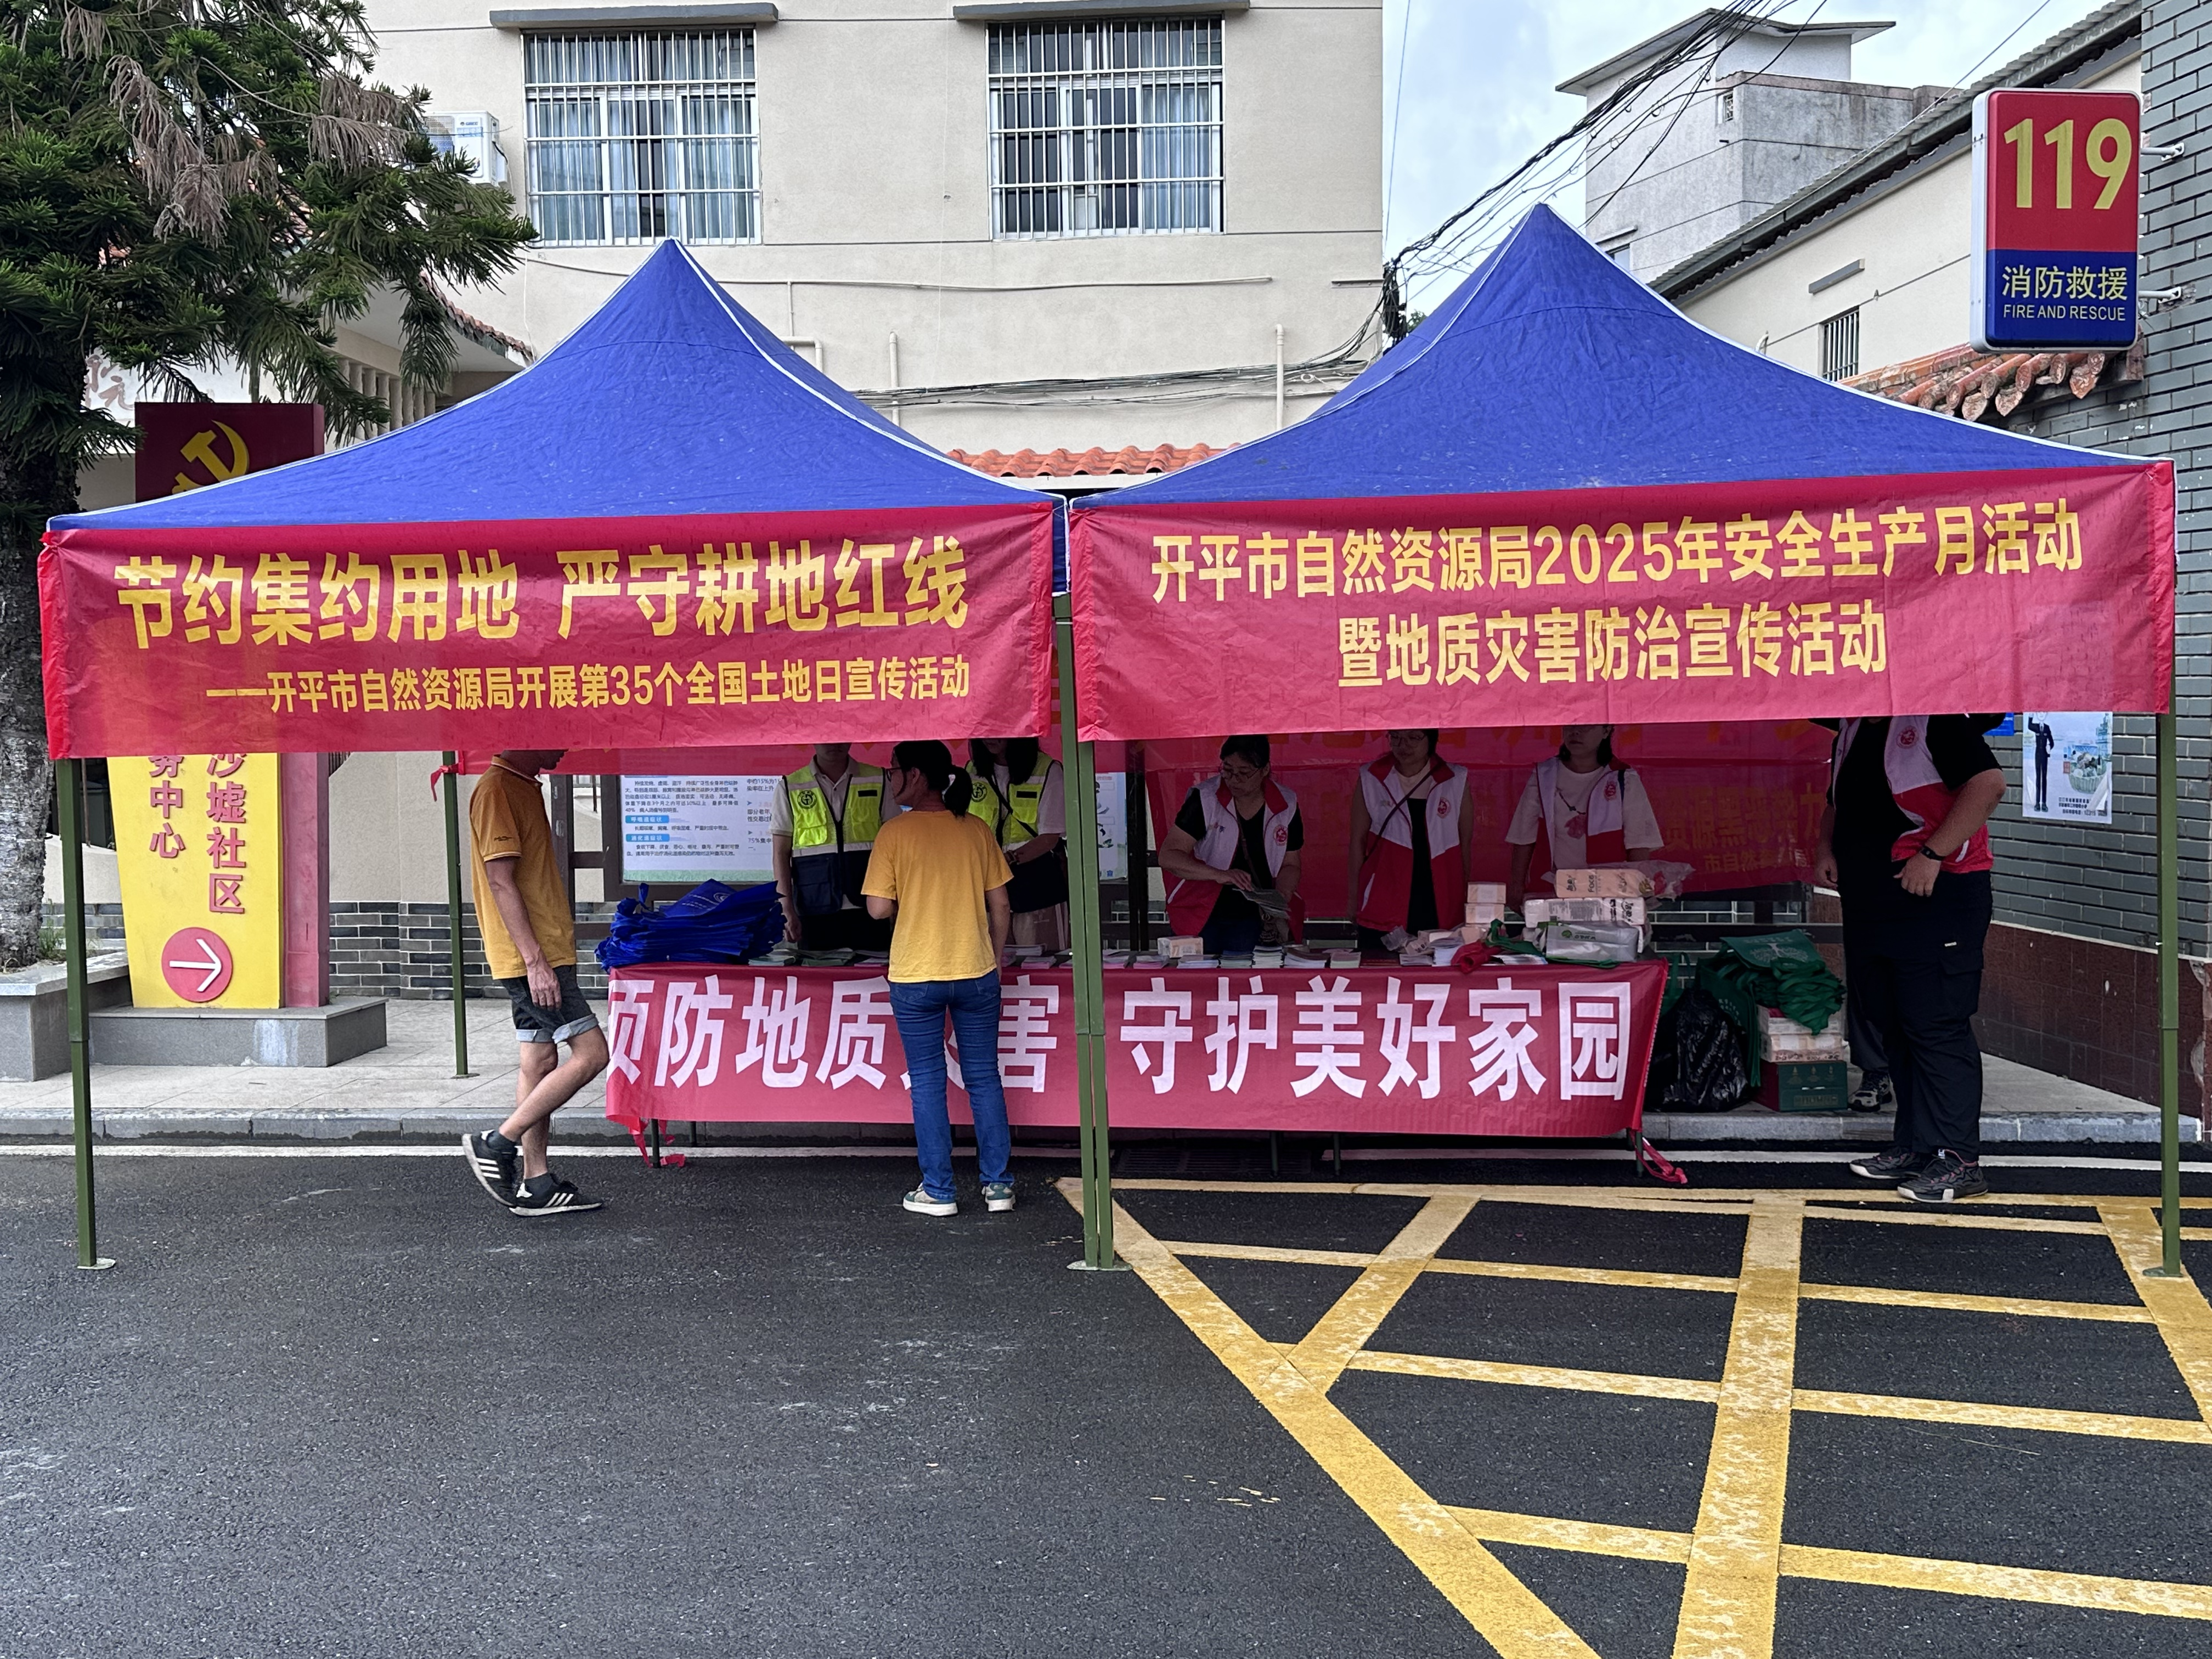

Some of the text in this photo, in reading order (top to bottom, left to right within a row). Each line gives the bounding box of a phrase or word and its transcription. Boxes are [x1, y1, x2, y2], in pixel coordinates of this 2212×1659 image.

[2004, 118, 2132, 209] 119
[2002, 265, 2128, 301] 消防救援
[2004, 304, 2126, 321] FIRE AND RESCUE
[115, 535, 968, 648] 节约集约用地 严守耕地红线
[1152, 498, 2083, 603] 开平市自然资源局2025年安全生产月活动
[1339, 599, 1886, 687] 暨地质灾害防治宣传活动
[1120, 974, 1630, 1101] 守护美好家园
